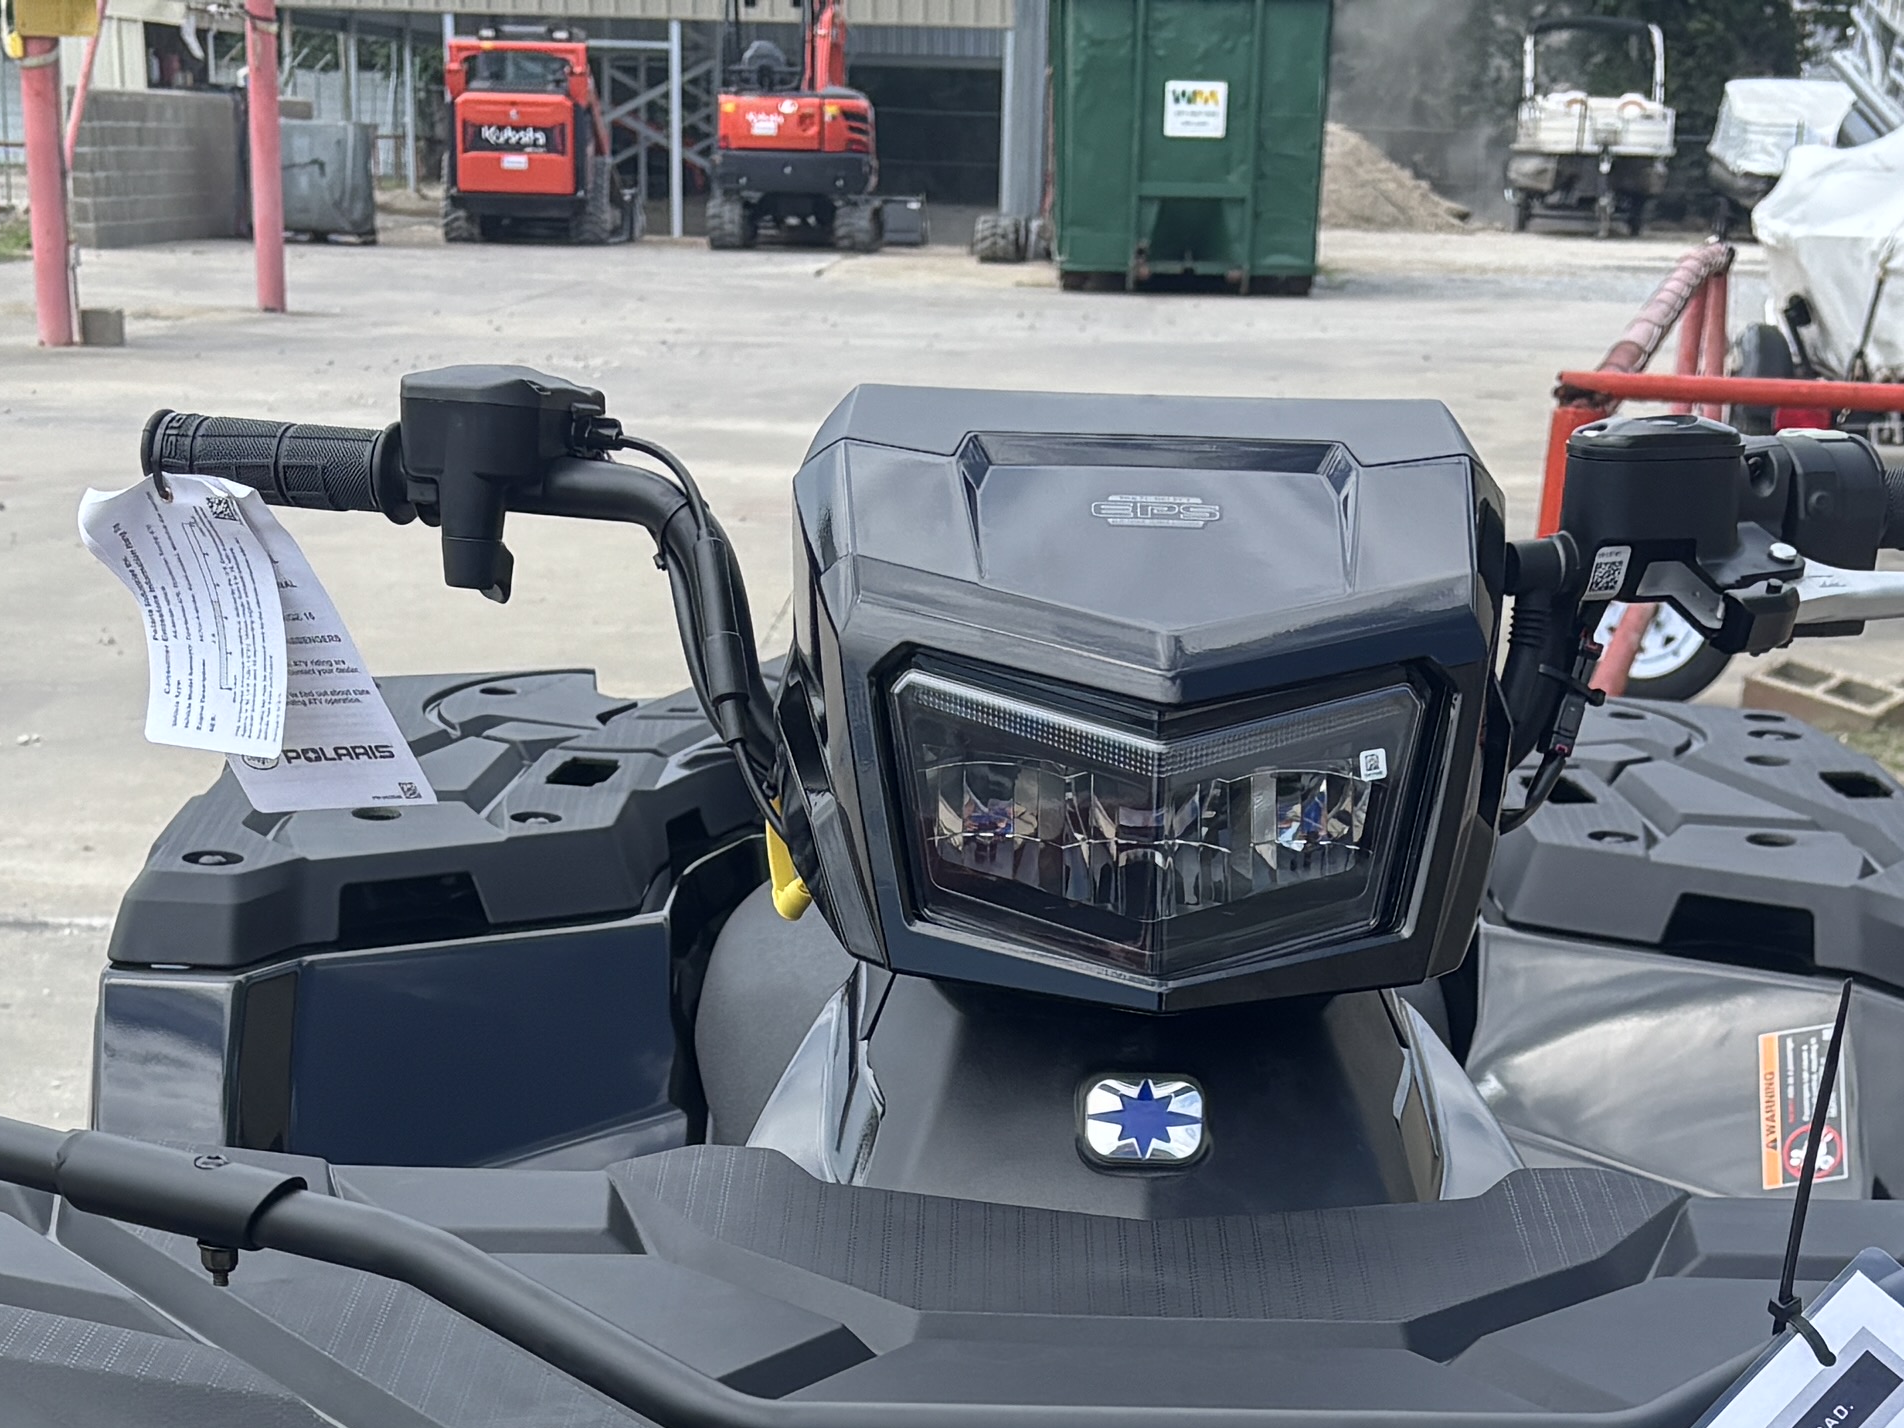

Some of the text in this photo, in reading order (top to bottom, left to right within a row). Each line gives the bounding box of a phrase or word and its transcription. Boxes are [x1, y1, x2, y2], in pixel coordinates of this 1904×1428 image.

[1091, 501, 1220, 521] EPS
[286, 745, 395, 764] POLARIS
[1763, 1070, 1776, 1138] WARNING
